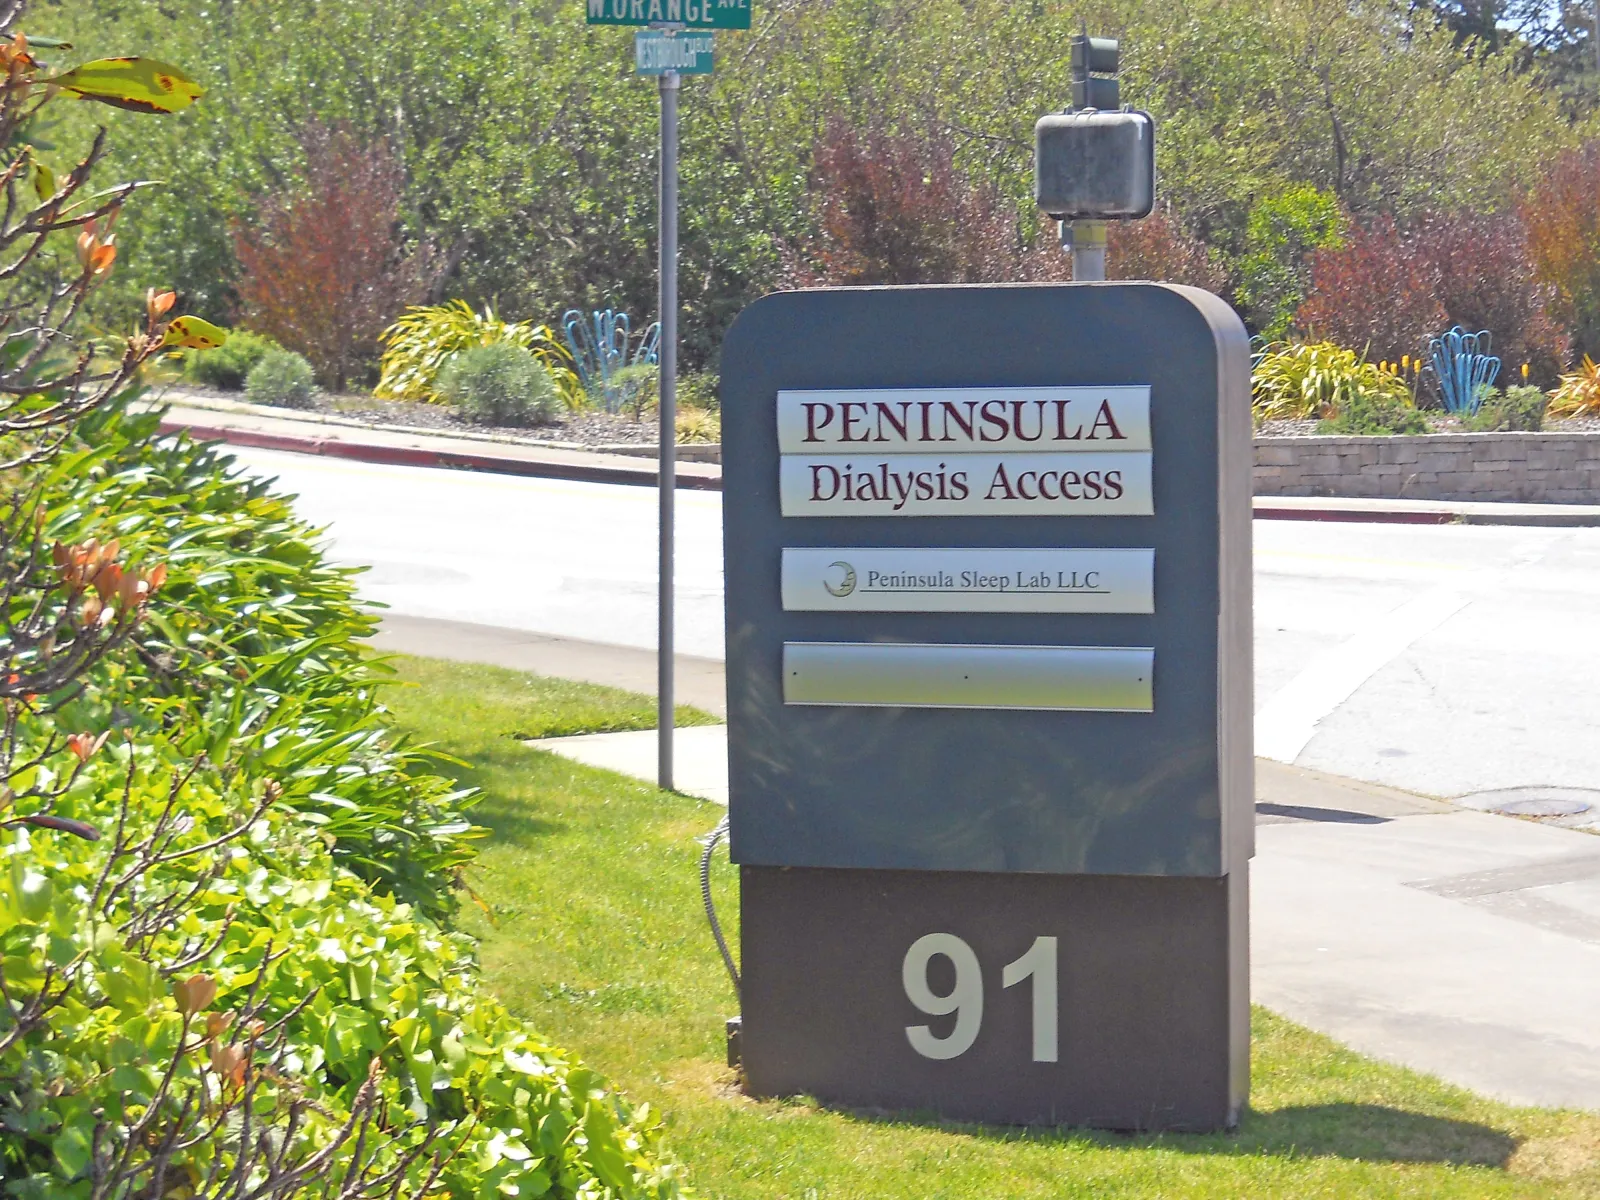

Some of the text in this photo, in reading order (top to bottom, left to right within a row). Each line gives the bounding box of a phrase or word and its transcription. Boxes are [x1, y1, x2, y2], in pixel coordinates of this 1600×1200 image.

[801, 398, 1127, 442] PENINSULA
[808, 462, 1124, 510] Dialysis Access
[868, 570, 1100, 591] Peninsula Sleep Lab LLC
[902, 932, 1058, 1062] 91
